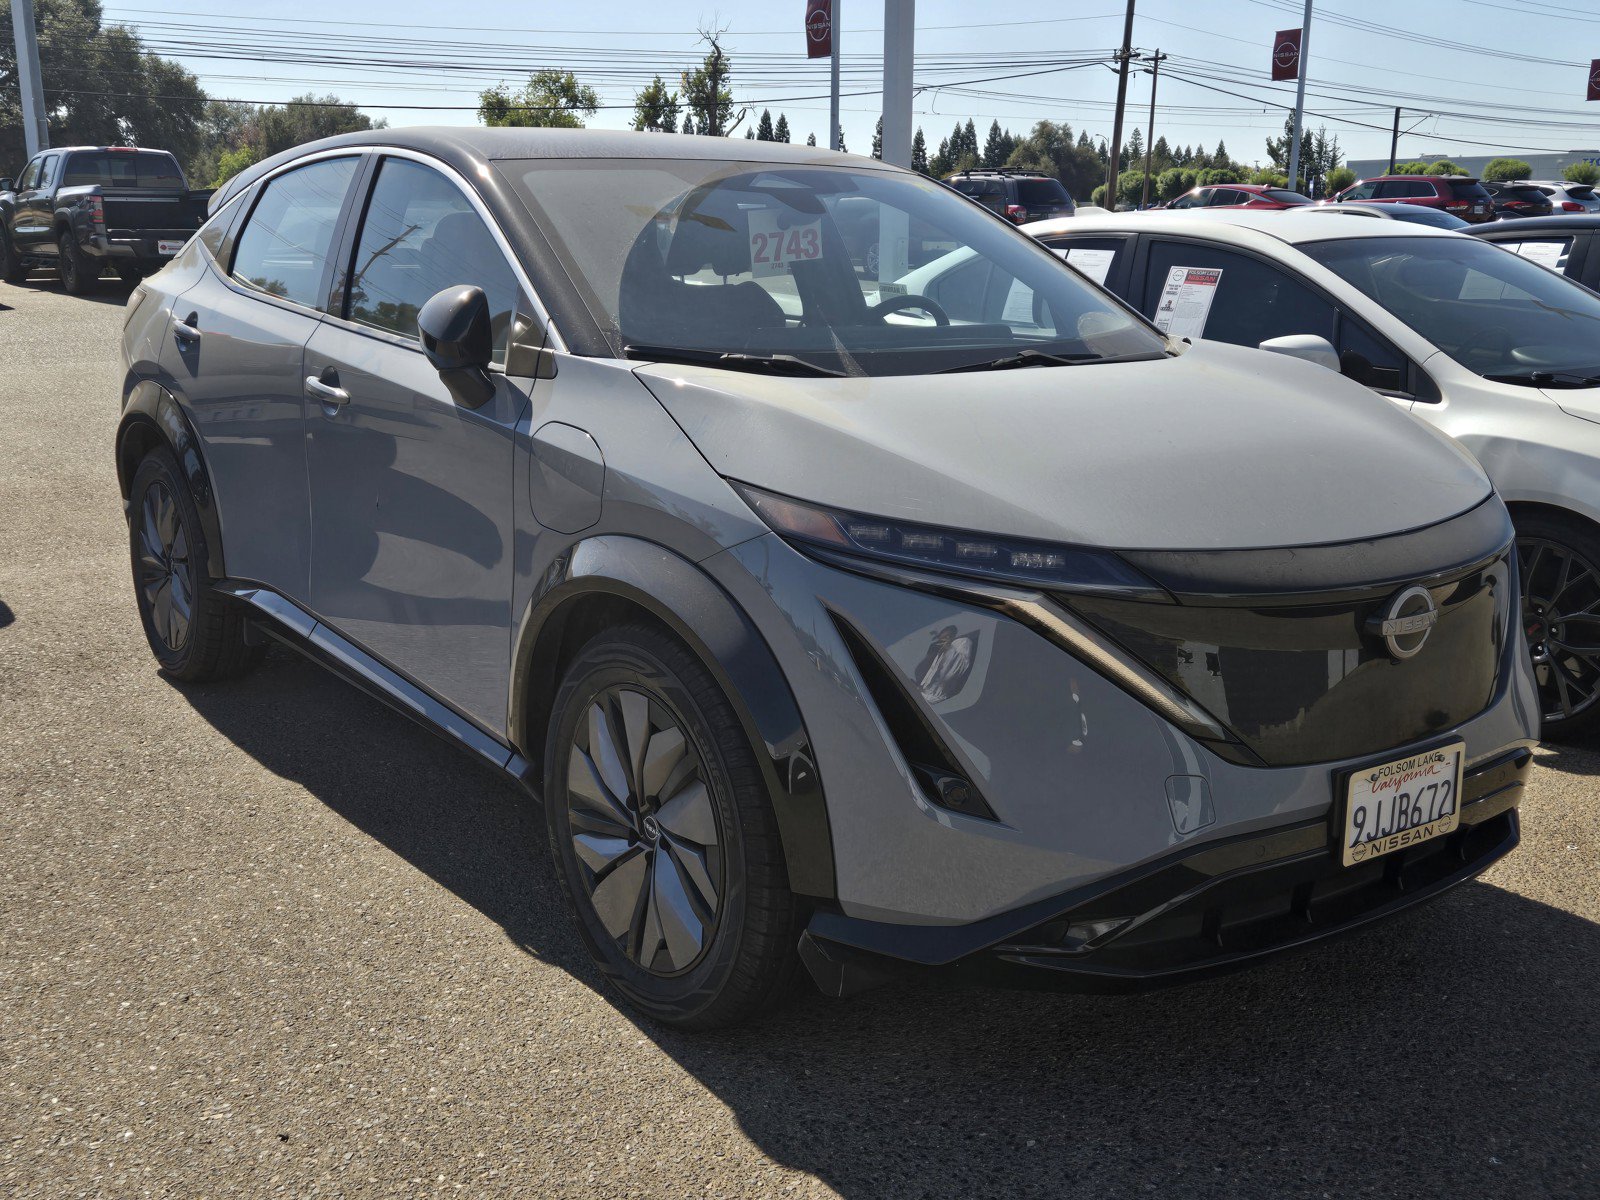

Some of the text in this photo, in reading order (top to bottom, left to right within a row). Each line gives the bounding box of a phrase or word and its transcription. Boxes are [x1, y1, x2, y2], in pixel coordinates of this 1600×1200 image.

[752, 228, 820, 264] 2743
[1385, 609, 1438, 634] NISSAN
[1371, 764, 1441, 793] California
[1378, 751, 1440, 778] FOLSOM LAKE
[1349, 779, 1452, 848] 9JJB672
[1370, 824, 1434, 856] NISSAN
